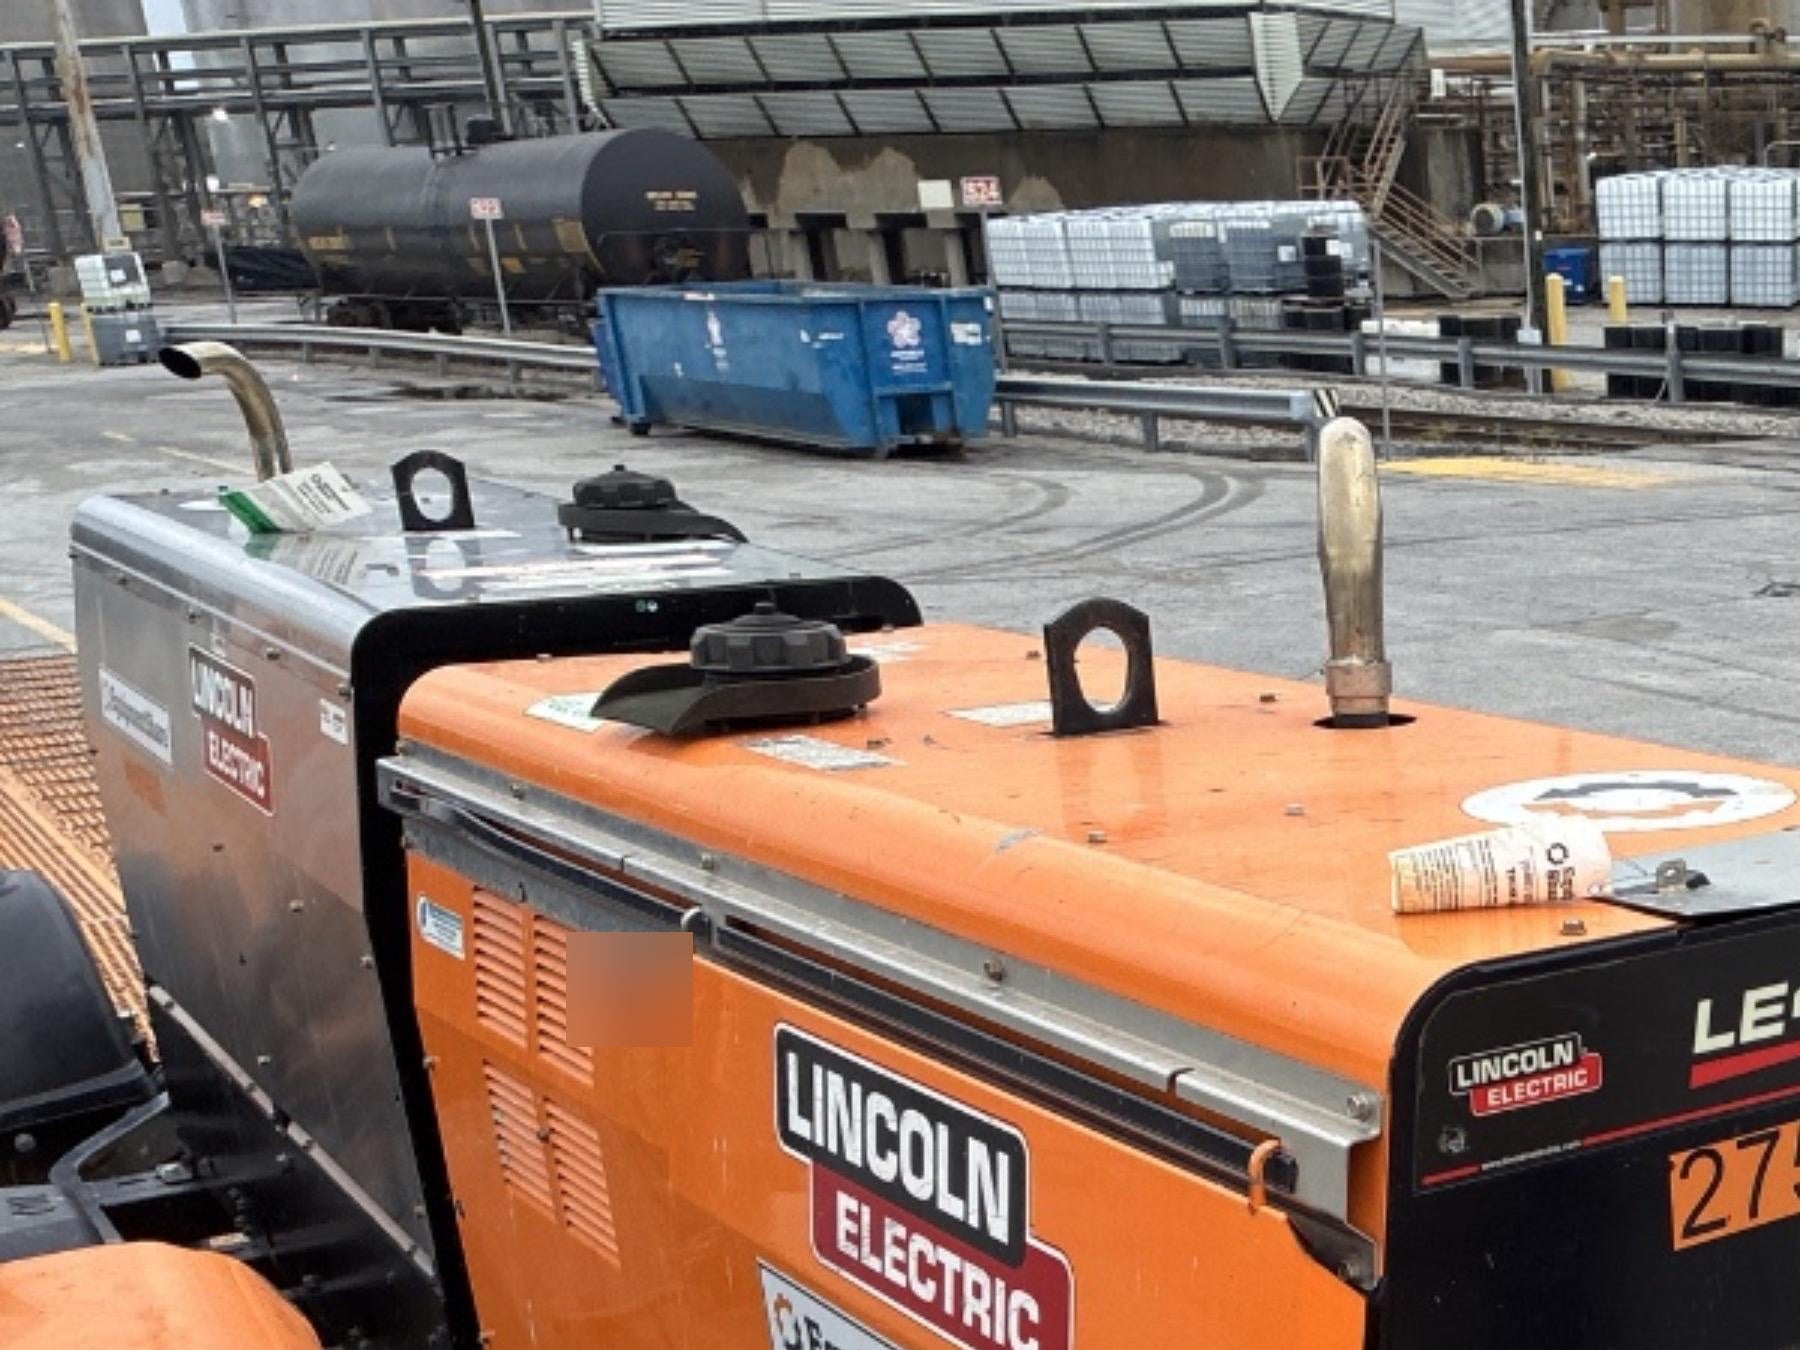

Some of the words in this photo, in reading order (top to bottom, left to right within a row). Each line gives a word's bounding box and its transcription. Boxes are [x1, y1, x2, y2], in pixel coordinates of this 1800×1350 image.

[1456, 1040, 1574, 1088] LINCOLN
[1487, 1069, 1588, 1107] ELECTRIC
[786, 1051, 1010, 1246] LINCOLN
